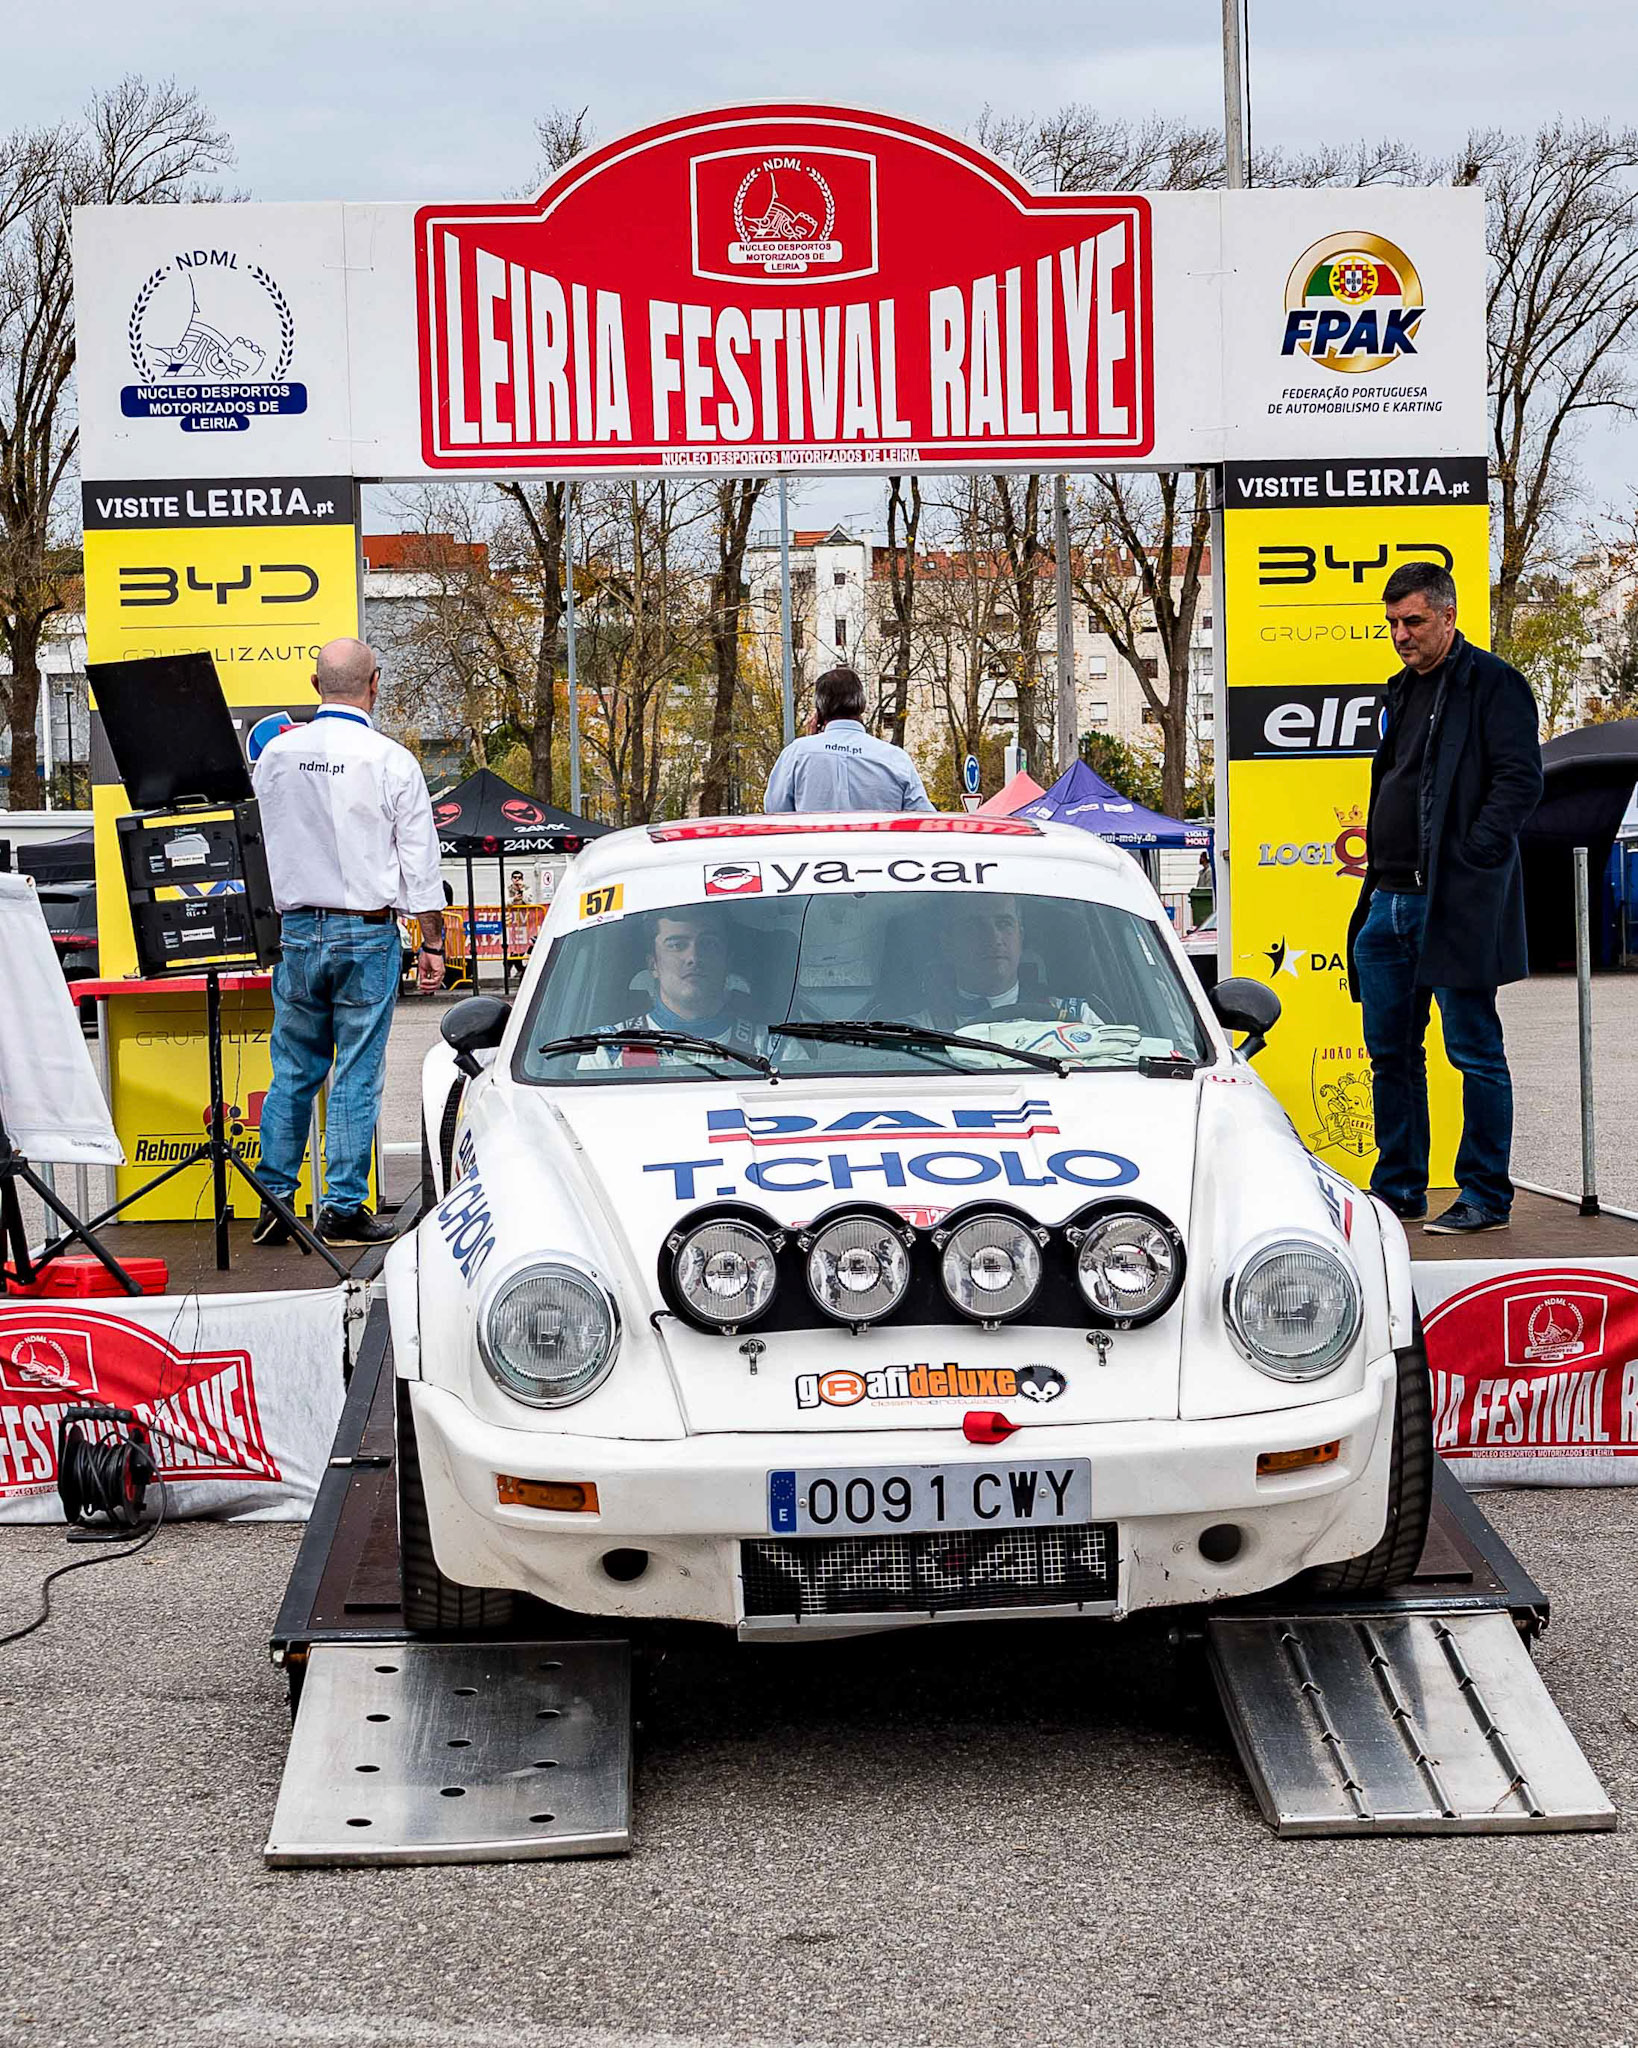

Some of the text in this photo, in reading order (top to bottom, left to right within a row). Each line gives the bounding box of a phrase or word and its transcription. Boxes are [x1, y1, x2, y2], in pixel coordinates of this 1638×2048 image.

[763, 157, 802, 172] NDML
[777, 243, 832, 252] DESPORTOS
[175, 249, 239, 271] NDML
[746, 252, 825, 261] MOTORIZADOS DE
[771, 263, 800, 271] LEIRIA
[443, 219, 1130, 445] LEIRIA FESTIVAL RALLYE
[1280, 307, 1426, 357] FPAK
[137, 384, 290, 400] NÚCLEO DESPORTOS
[1282, 385, 1428, 401] FEDERAÇÃO PORTUGUESA
[149, 400, 280, 415] MOTORIZADOS DE
[1267, 401, 1443, 414] DE AUTOMOBILISMO E KARTING
[191, 416, 239, 430] LEIRIA
[711, 450, 779, 464] DESPORTOS
[781, 449, 863, 463] MOTORIZADOS
[865, 449, 880, 462] DE
[882, 448, 921, 462] LEIRIA
[1238, 468, 1470, 498] VISITE LEIRIA.pt
[96, 487, 335, 519] VISITE LEIRIA.pt
[1258, 543, 1455, 586] BYD
[119, 564, 320, 607] BYD
[1263, 695, 1376, 748] elf
[825, 743, 863, 756] ndml.pt
[299, 761, 345, 776] ndml.pt
[503, 838, 555, 852] 24MX
[1096, 832, 1157, 845] qui-moly.de
[771, 860, 999, 894] ya-car
[586, 886, 615, 916] 57
[642, 1149, 1141, 1201] T.CHOLO
[1468, 1368, 1610, 1444] FESTIVAL
[1538, 1449, 1583, 1458] MOTORIZADOS
[1583, 1449, 1592, 1457] DE
[1593, 1449, 1615, 1457] LEIRIA
[807, 1469, 1075, 1525] 0091 CWY
[778, 1508, 789, 1523] E
